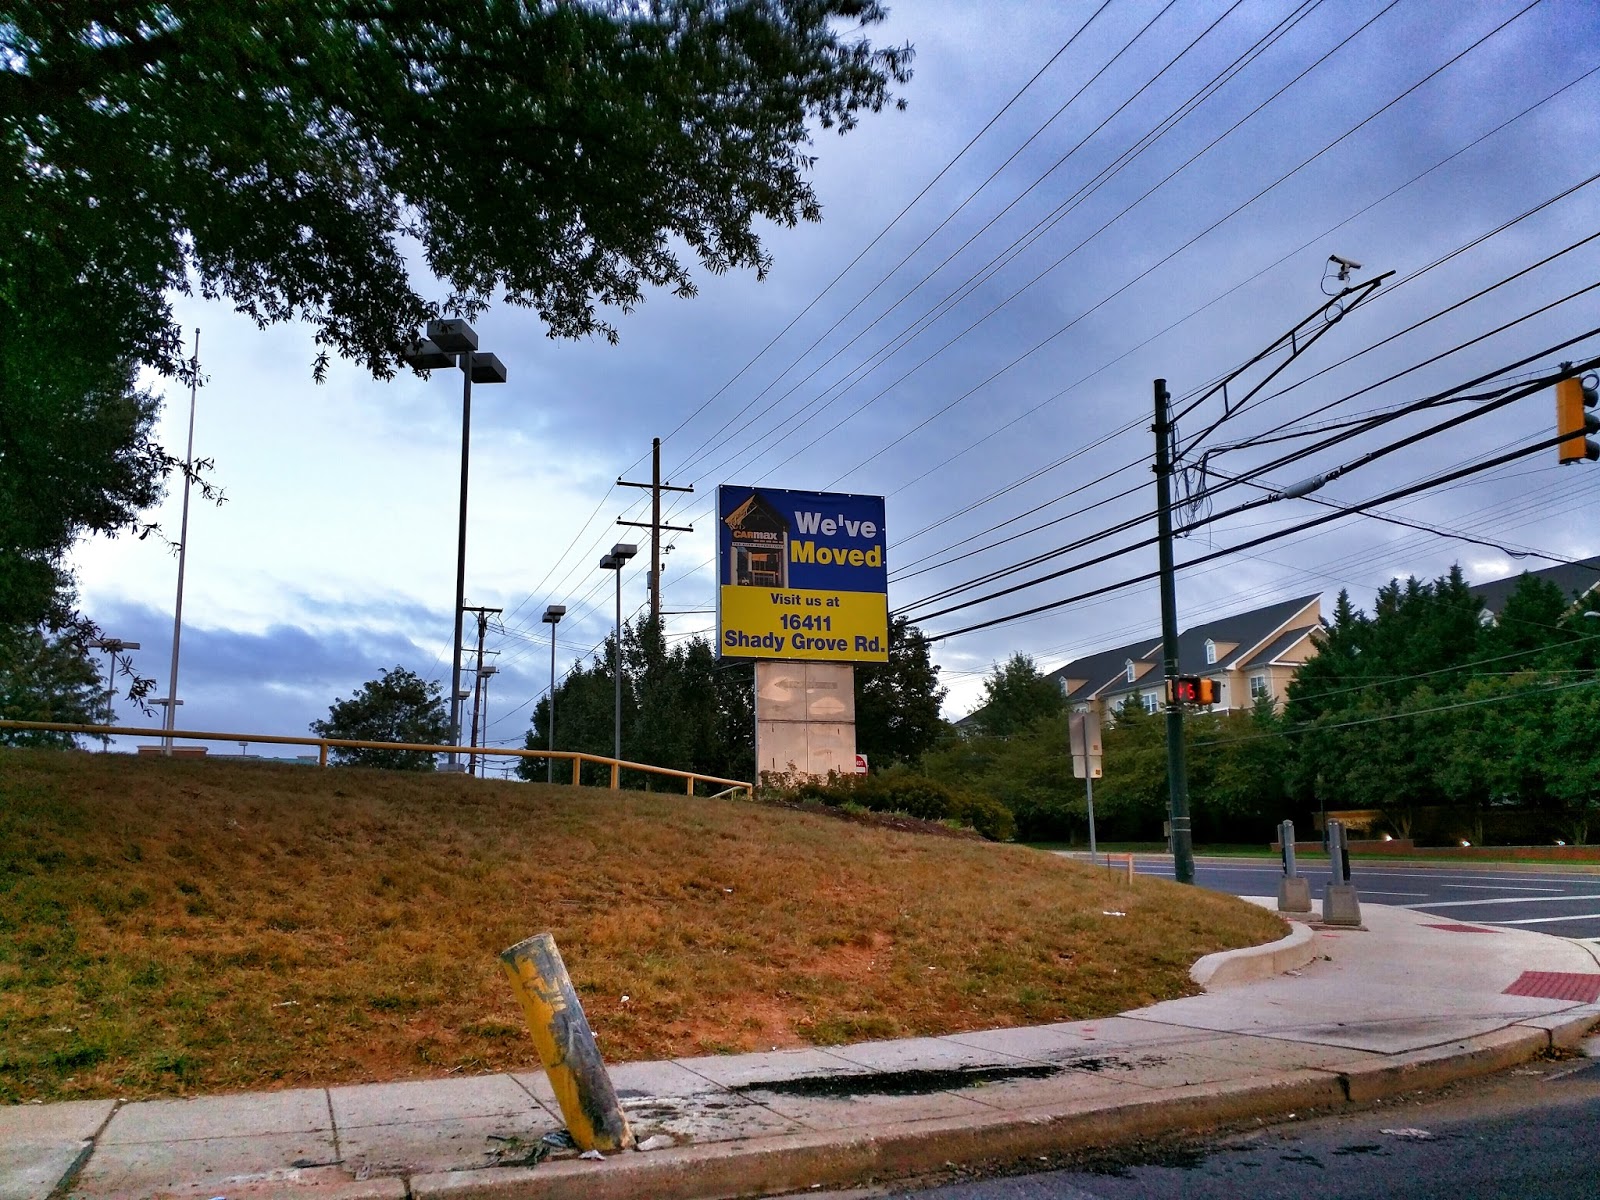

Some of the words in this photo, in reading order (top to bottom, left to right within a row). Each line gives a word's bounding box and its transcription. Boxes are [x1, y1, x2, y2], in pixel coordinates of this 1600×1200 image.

[794, 511, 877, 538] We've
[790, 540, 882, 567] Moved
[770, 593, 801, 606] Visit
[805, 596, 821, 607] us
[826, 597, 840, 607] at
[780, 613, 831, 631] 16411
[724, 630, 785, 652] Shady
[791, 633, 848, 651] Grove
[854, 636, 885, 652] Rd.
